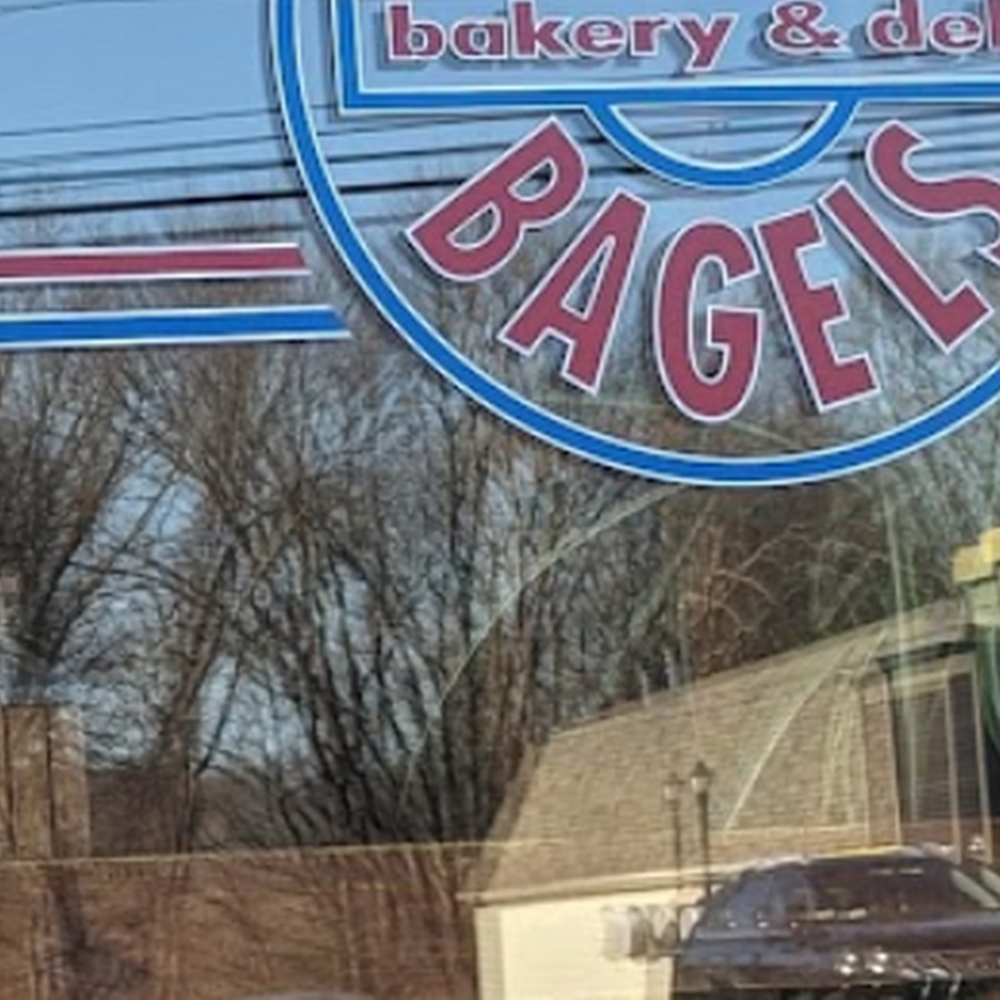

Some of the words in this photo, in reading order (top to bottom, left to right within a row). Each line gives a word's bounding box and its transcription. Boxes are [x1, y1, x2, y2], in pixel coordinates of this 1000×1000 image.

[385, 0, 739, 73] bakery
[767, 0, 848, 55] &
[404, 115, 1000, 424] BAGELS
